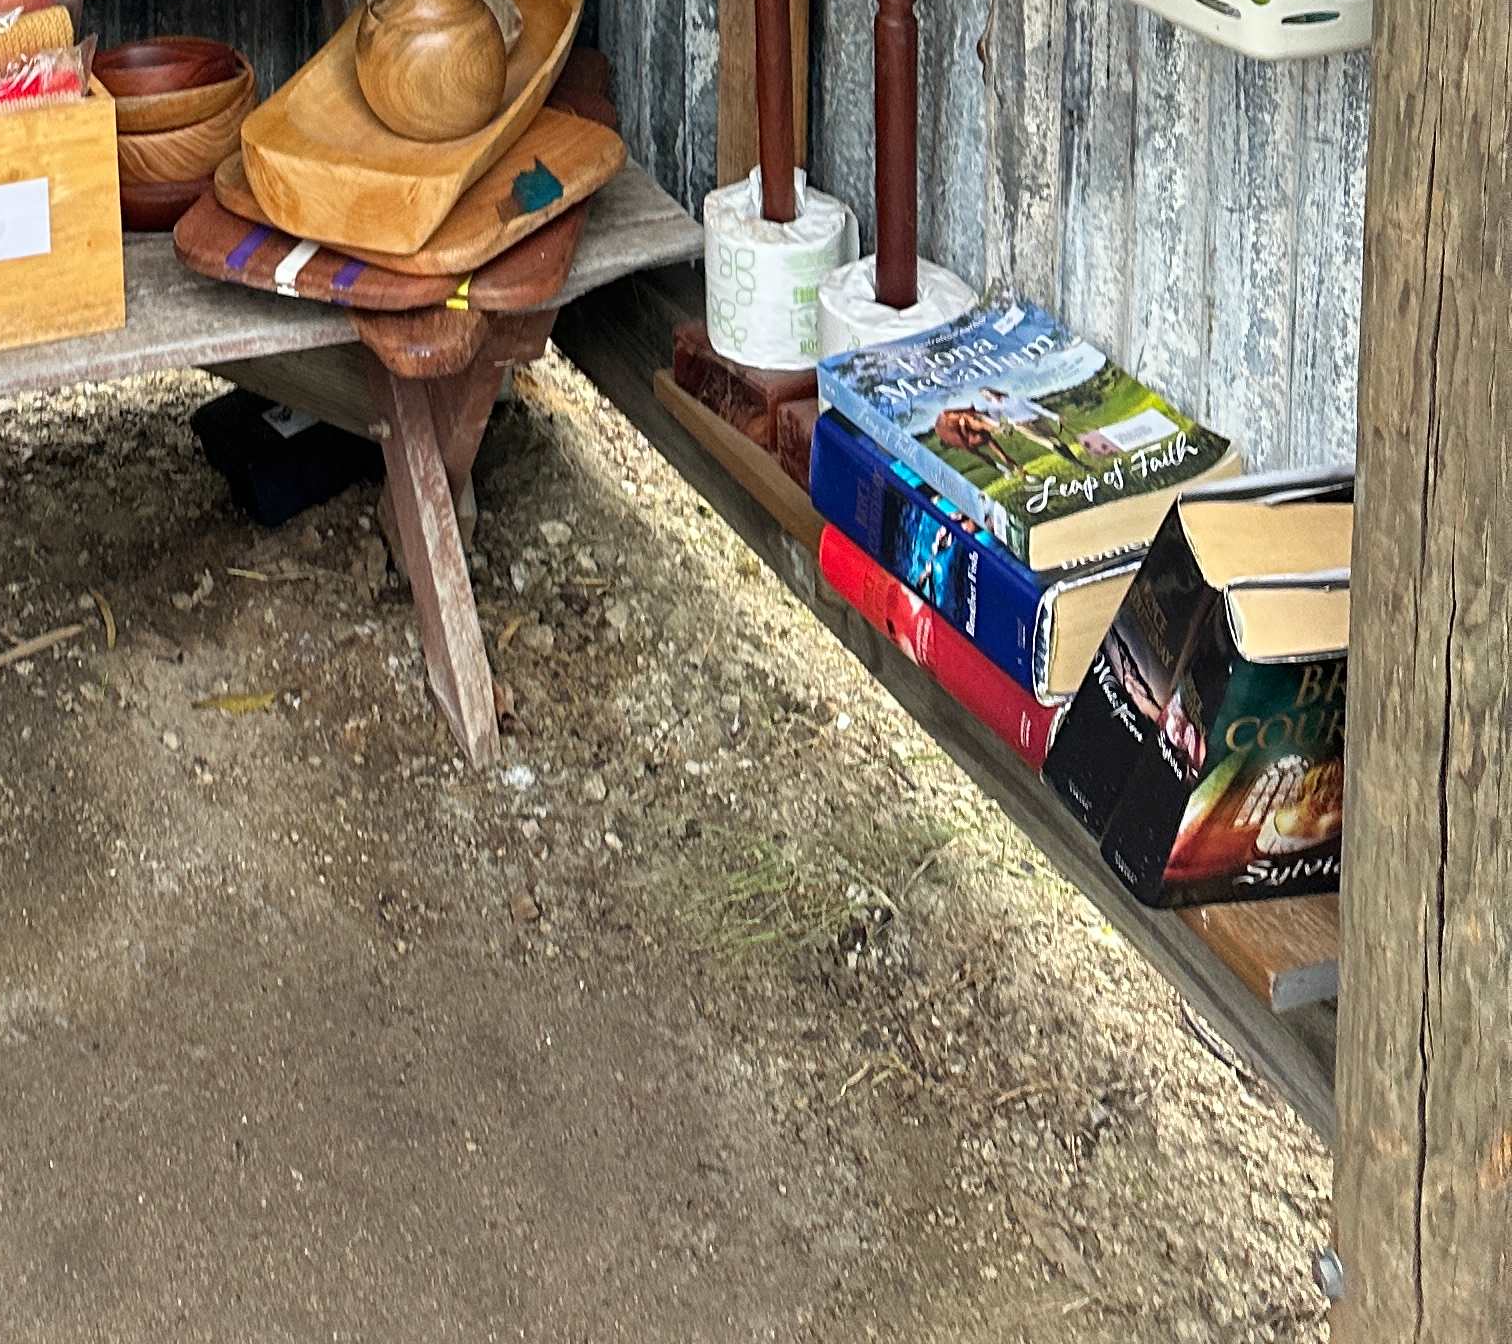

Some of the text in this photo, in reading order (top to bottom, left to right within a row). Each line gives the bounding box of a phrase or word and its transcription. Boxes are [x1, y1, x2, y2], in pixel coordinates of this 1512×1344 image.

[874, 332, 1055, 404] McCallum
[1025, 430, 1199, 514] Leap of Faith
